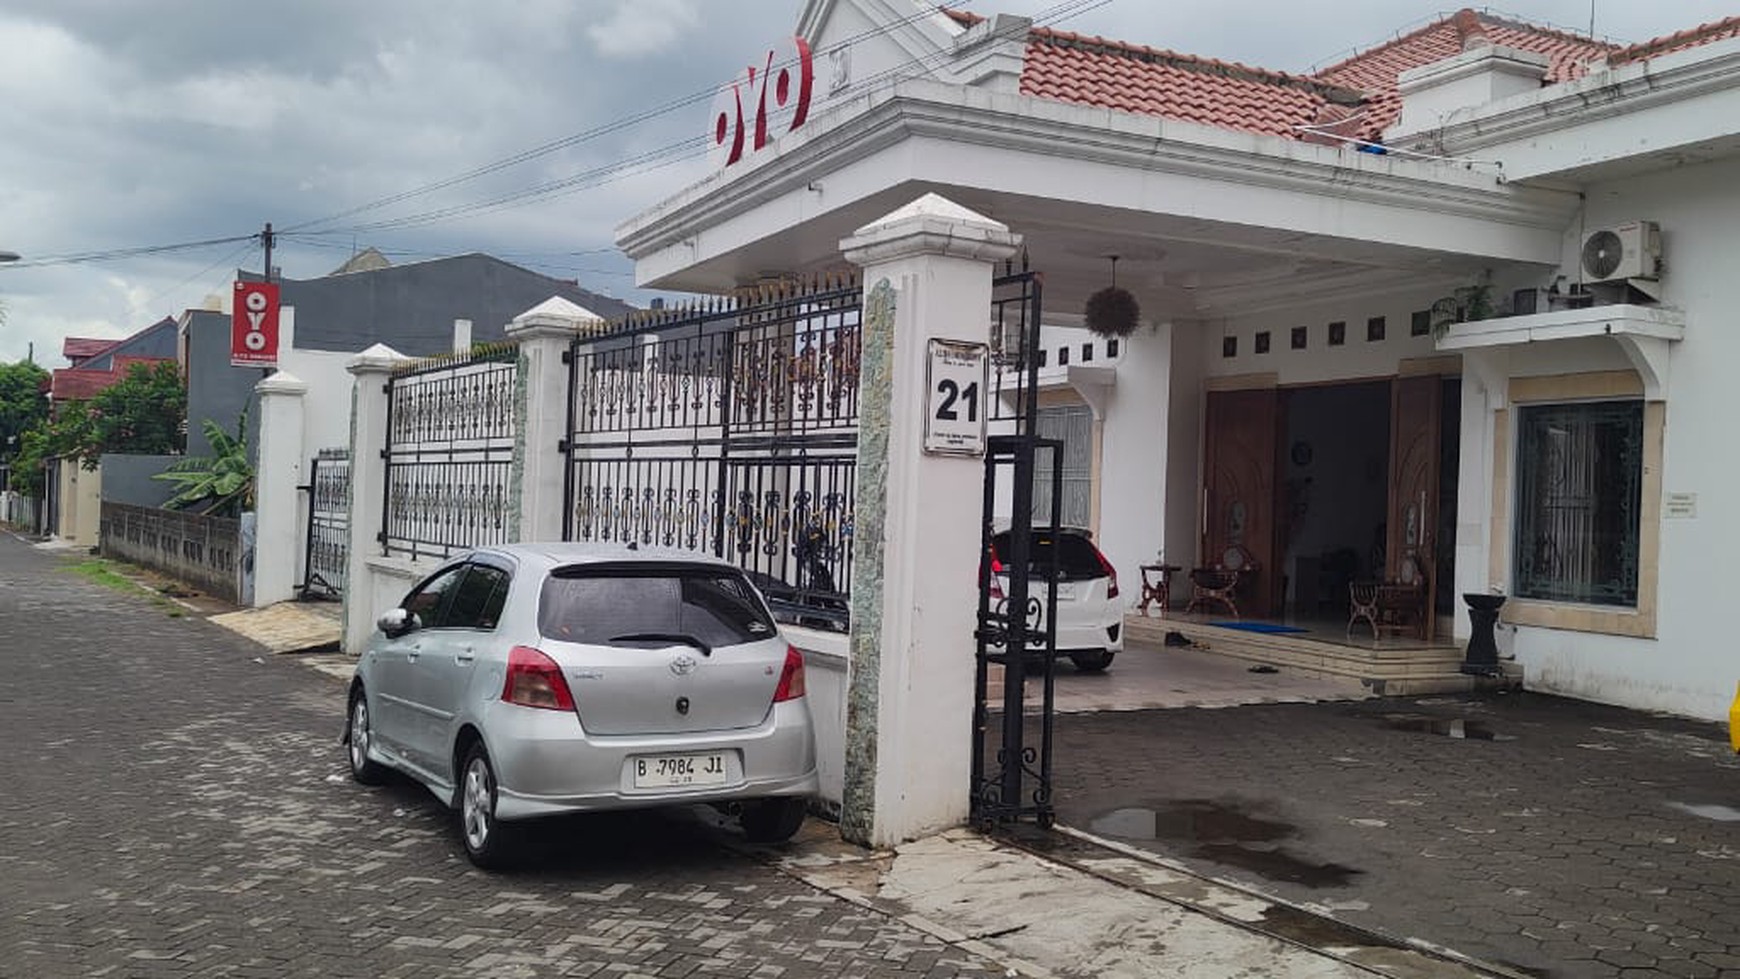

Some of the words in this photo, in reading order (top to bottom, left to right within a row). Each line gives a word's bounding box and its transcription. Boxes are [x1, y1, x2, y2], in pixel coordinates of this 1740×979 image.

[708, 36, 814, 168] OYO
[245, 291, 267, 351] OYO
[936, 378, 978, 422] 21
[638, 759, 647, 776] B
[658, 758, 694, 776] 7984
